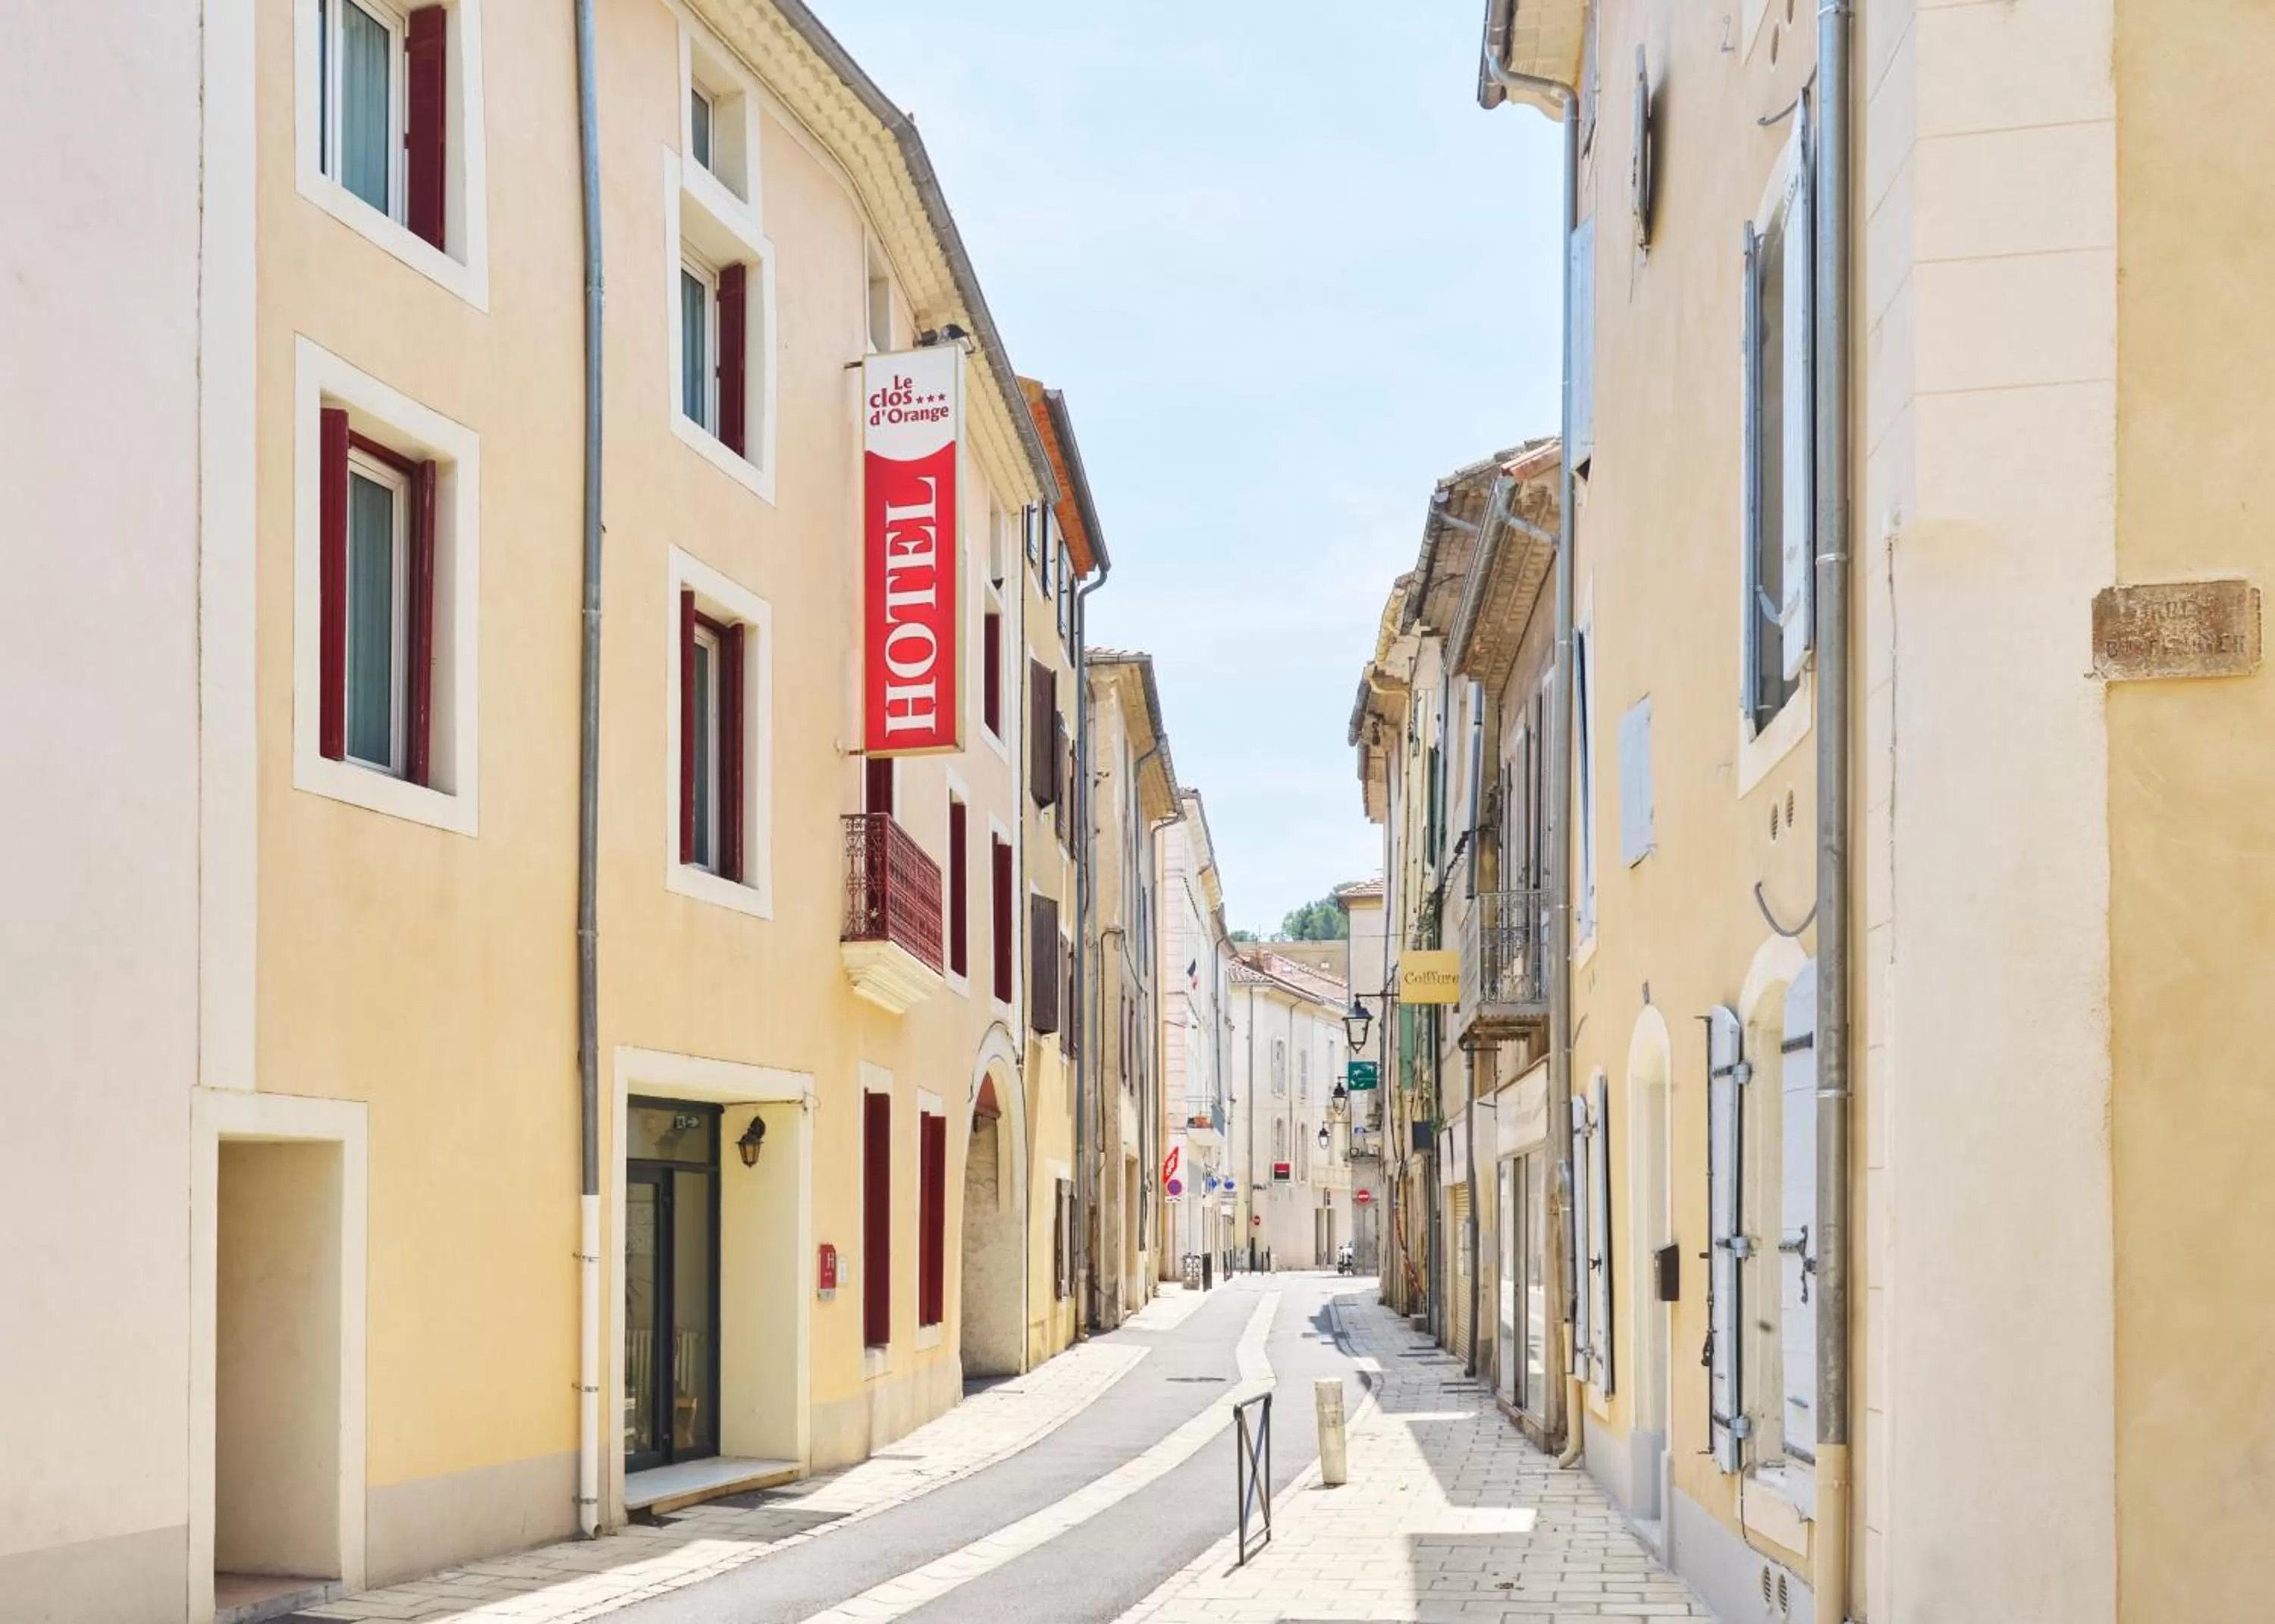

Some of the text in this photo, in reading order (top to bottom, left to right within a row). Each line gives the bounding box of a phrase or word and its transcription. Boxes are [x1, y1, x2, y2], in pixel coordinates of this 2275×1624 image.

[894, 375, 912, 390] Le
[870, 387, 912, 408] clos
[870, 406, 949, 425] d'Orange
[885, 476, 937, 738] HOTEL
[1404, 970, 1460, 984] Coiffure
